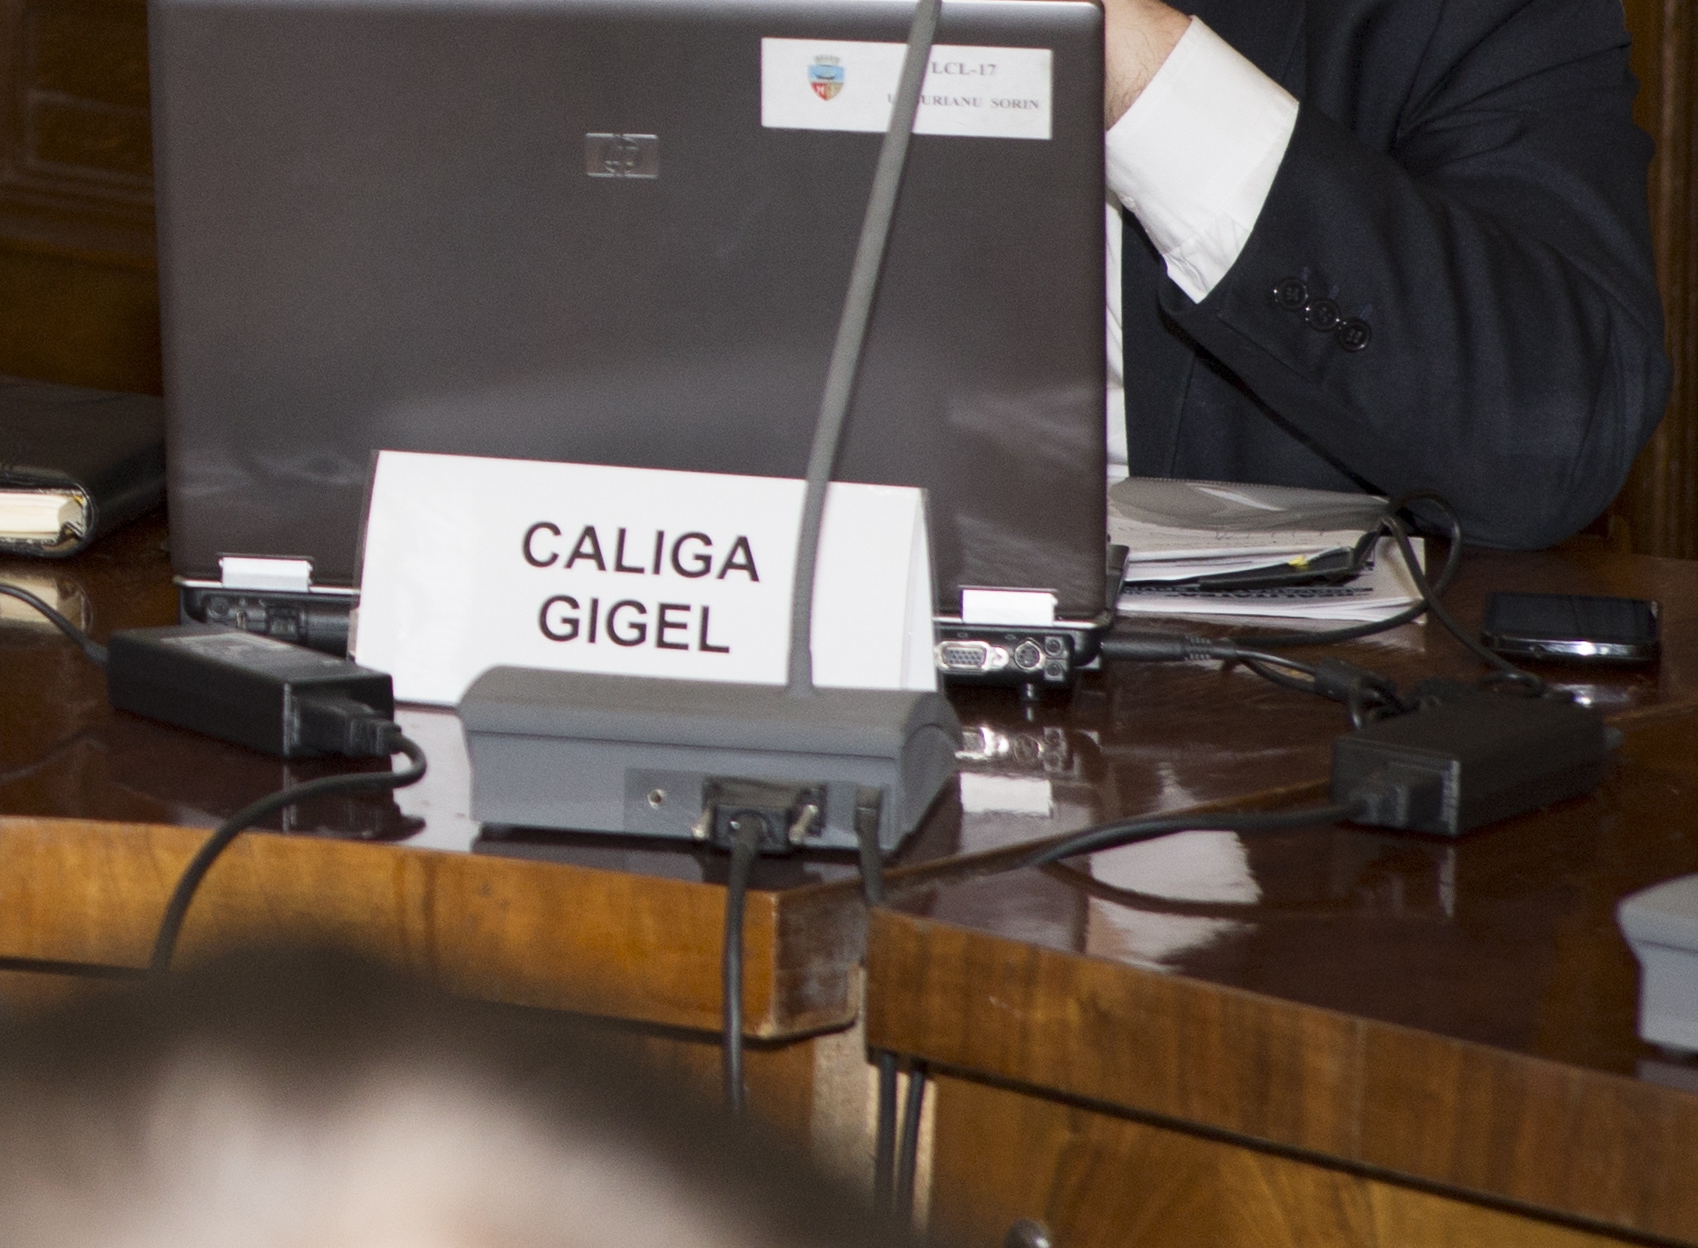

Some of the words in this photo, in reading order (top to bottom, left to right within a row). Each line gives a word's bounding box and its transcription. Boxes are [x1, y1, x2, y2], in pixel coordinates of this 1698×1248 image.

[931, 61, 996, 76] LCL-17
[887, 93, 982, 108] URIANU
[991, 98, 1040, 109] SORIN
[522, 521, 761, 582] CALIGA
[538, 594, 731, 654] GIGEL
